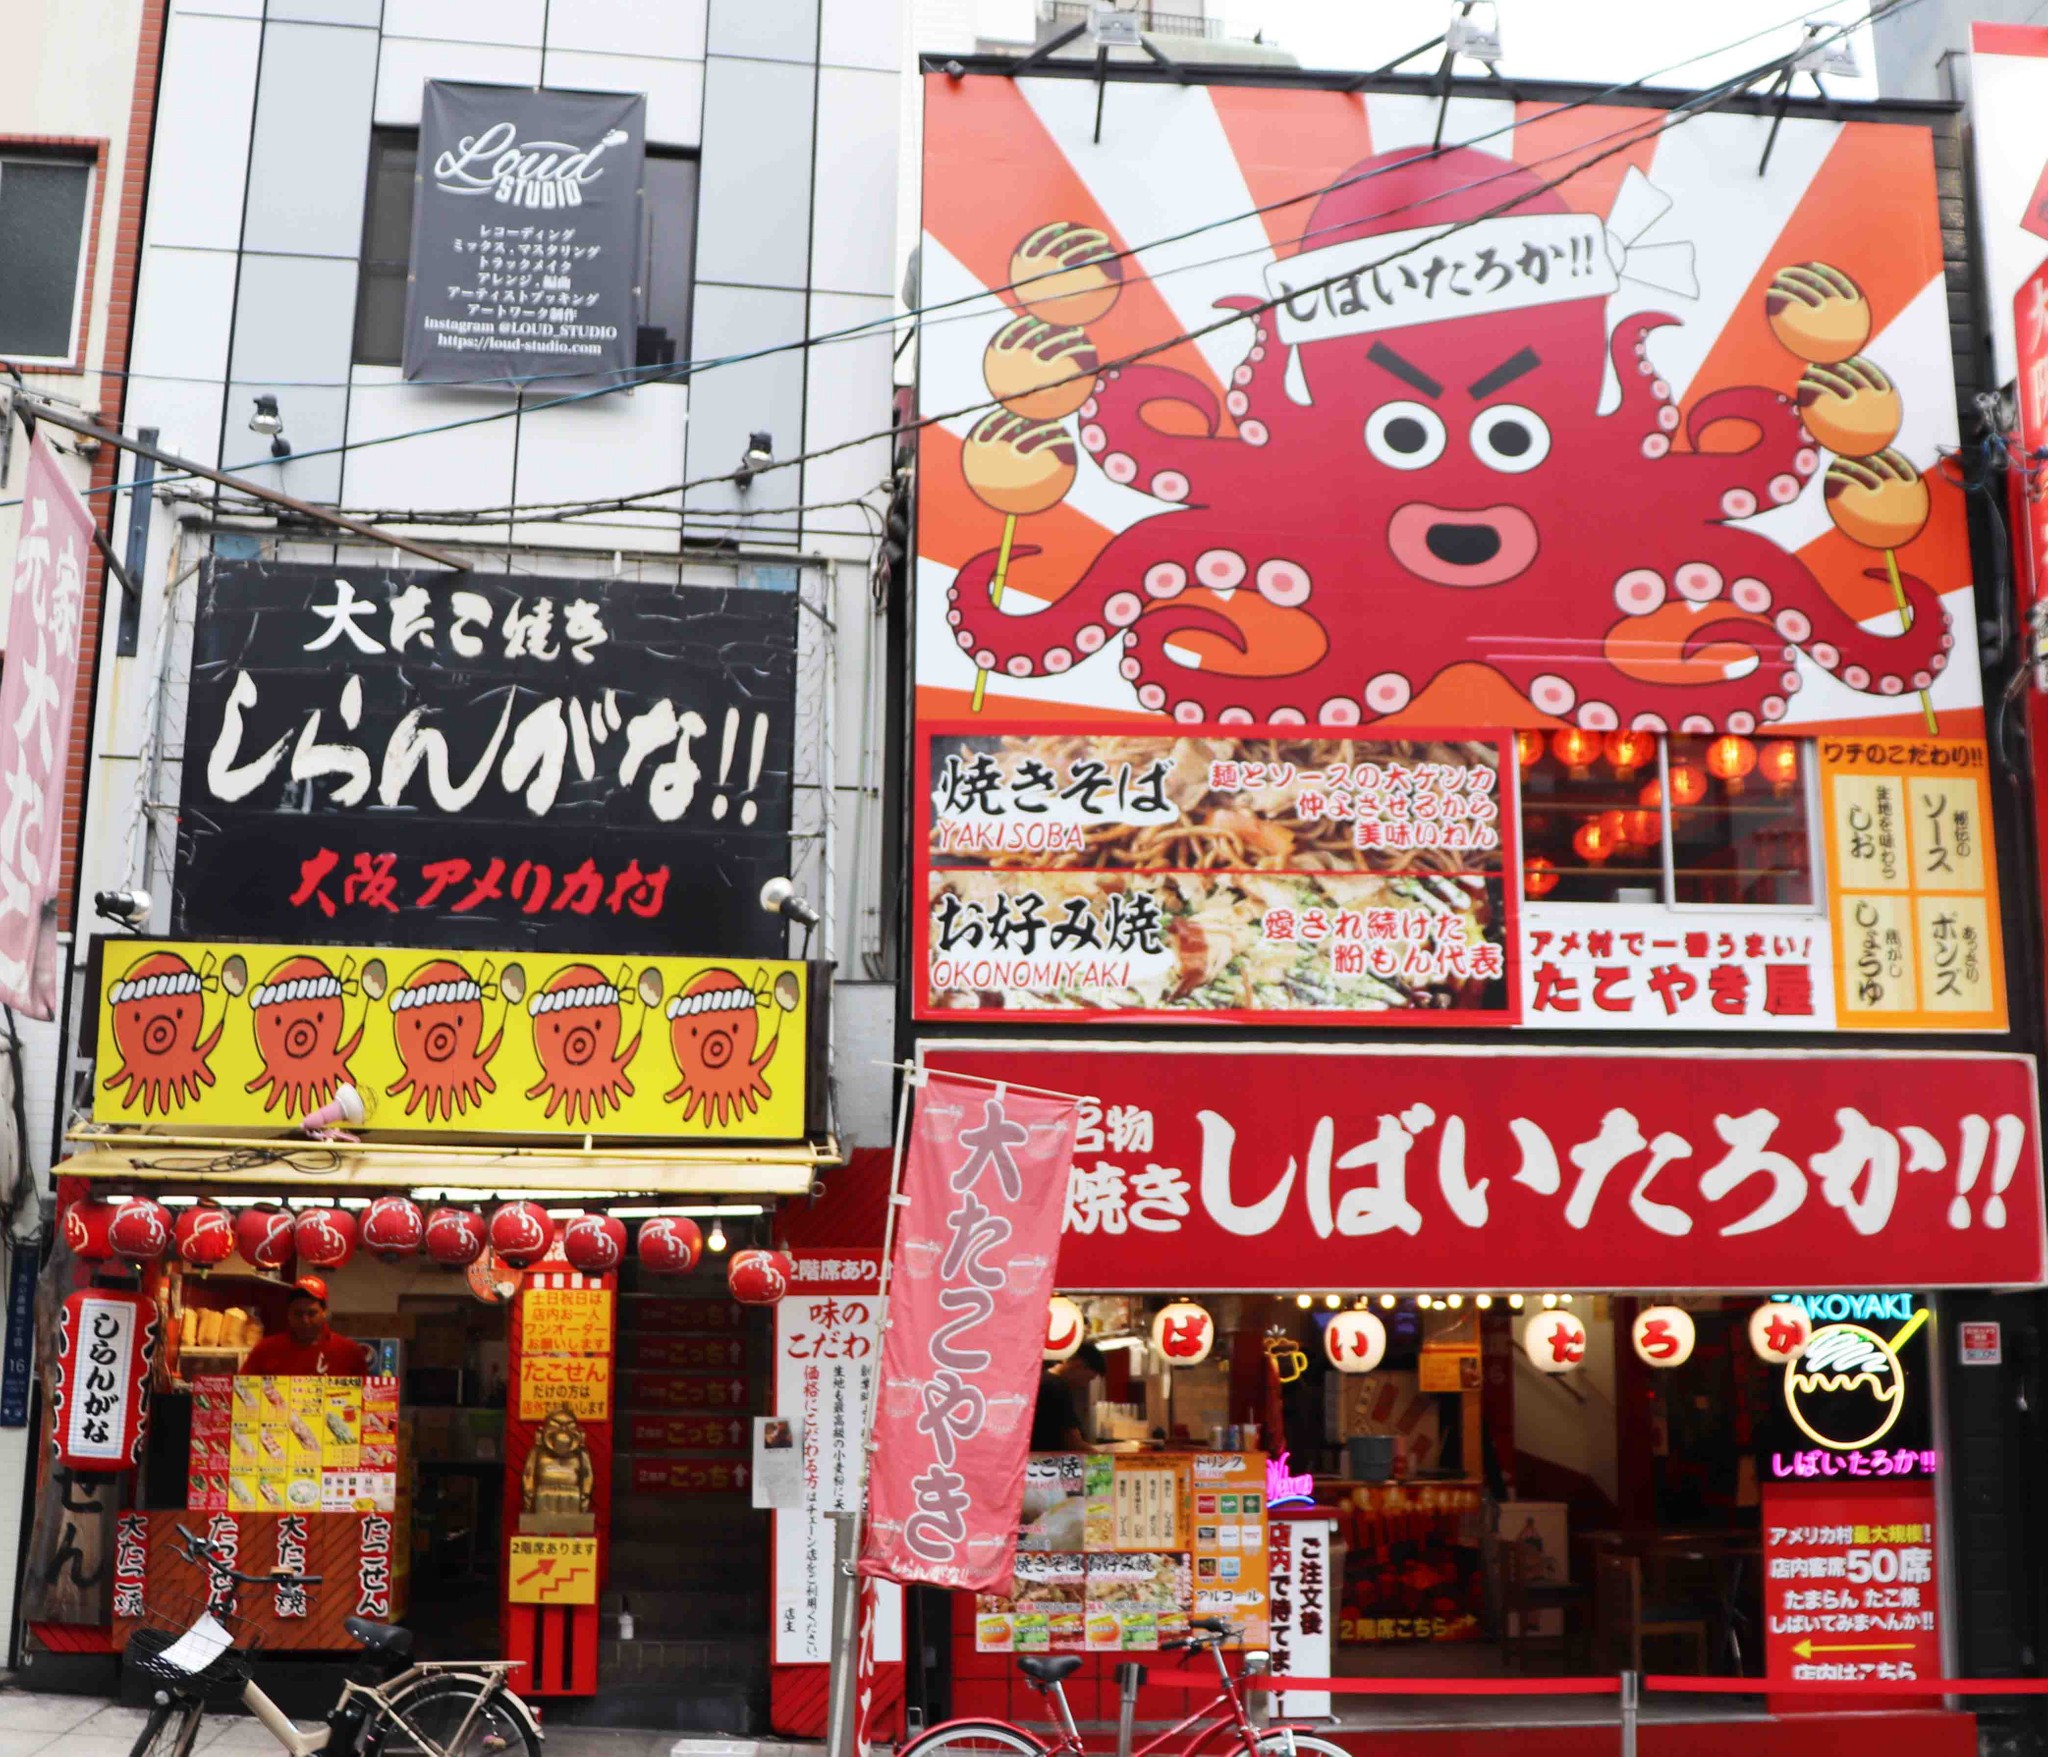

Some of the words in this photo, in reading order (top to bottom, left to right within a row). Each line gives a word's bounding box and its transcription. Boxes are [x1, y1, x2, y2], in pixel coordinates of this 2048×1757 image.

[434, 122, 629, 187] Loud
[494, 175, 583, 209] STUDIO
[480, 224, 576, 242] レコーディング
[478, 255, 572, 273] トラックメイク
[447, 285, 600, 306] アーティストブッキング
[466, 303, 578, 322] アートワーク制作
[424, 316, 494, 334] instagram
[498, 320, 617, 340] @LOUD_STUDIO
[437, 333, 602, 356] https://loud-studio.com
[303, 578, 609, 664] 大たこ焼き
[206, 668, 769, 827] しらんがな!!
[941, 753, 1176, 815] 焼きそば
[1210, 762, 1497, 791] 麺とソースの大ゲンカ
[1299, 792, 1498, 819] 仲よさせるから
[937, 821, 1085, 850] YAKISOBA
[1356, 821, 1498, 849] 美味いねん
[1849, 804, 1876, 860] しお
[1923, 793, 1954, 874] ソース
[937, 892, 1164, 956] お好み焼
[1264, 909, 1467, 941] 愛され続けた
[1332, 943, 1503, 976] 粉もん代表
[1855, 899, 1885, 1007] しょうゆ
[932, 960, 1131, 988] OKONOMIYAKI
[1532, 961, 1815, 1016] たこやき屋
[1195, 1100, 2027, 1239] しばいたろか!!
[809, 1296, 870, 1330] 味の
[524, 1323, 608, 1336] ワンオーダー
[903, 1097, 1030, 1565] 大たこやき
[1162, 1313, 1207, 1358] ば
[1330, 1325, 1368, 1362] い
[1548, 1321, 1585, 1363] た
[1639, 1318, 1682, 1359] ろ
[1764, 1313, 1805, 1354] か
[81, 1311, 120, 1444] しらんがな
[523, 1360, 607, 1383] たこせん
[533, 1384, 591, 1399] だけの方は
[1772, 1448, 1936, 1477] しばいたろか!!
[511, 1540, 596, 1556] 2階席あります
[274, 1512, 308, 1618] 大た焼
[1016, 1553, 1084, 1573] 焼きそば
[1196, 1589, 1258, 1602] アルコール
[1784, 1588, 1860, 1610] たまらん
[1863, 1586, 1921, 1609] たこ焼
